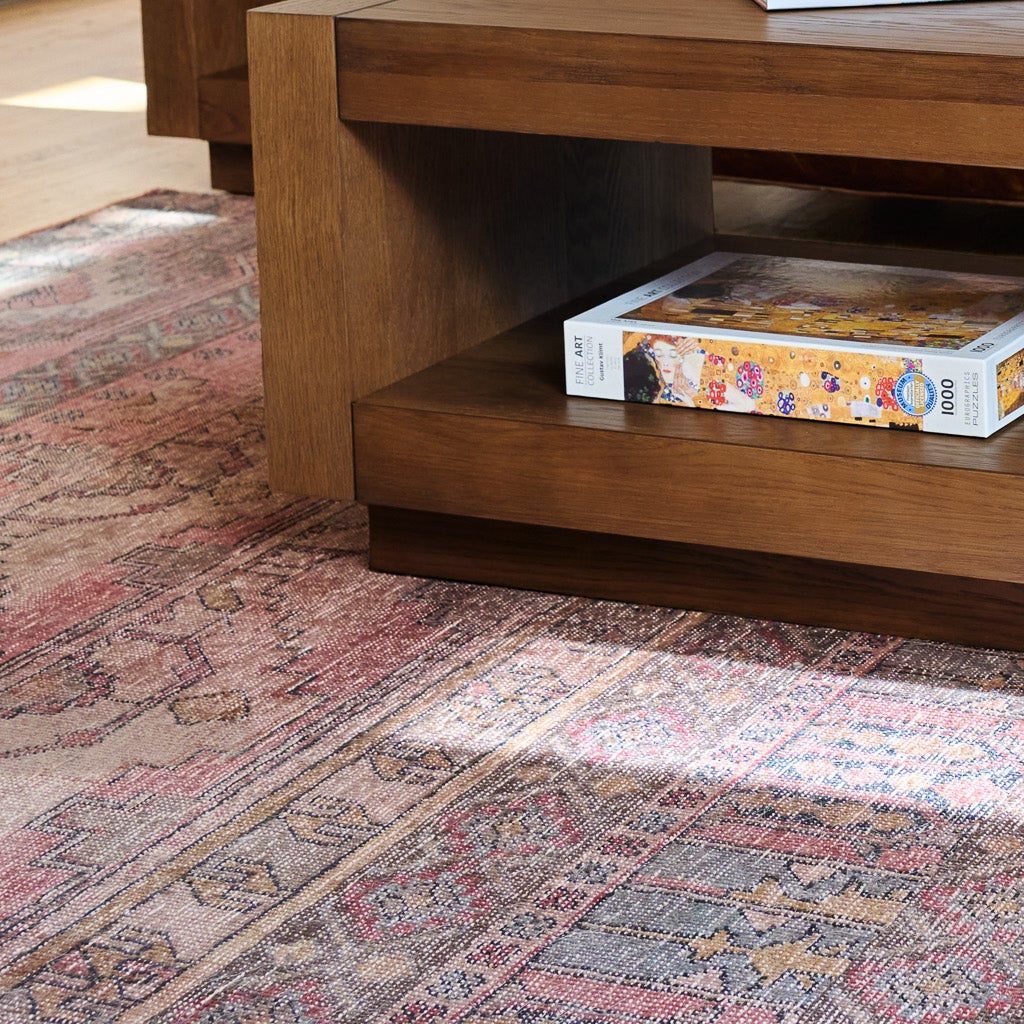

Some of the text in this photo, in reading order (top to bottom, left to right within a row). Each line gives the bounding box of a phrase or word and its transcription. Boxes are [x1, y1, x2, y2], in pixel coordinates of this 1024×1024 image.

[574, 335, 584, 385] FINE ART
[586, 336, 595, 386] COLLECTION
[896, 377, 908, 409] MUSEUM
[926, 383, 935, 410] QUALITY
[941, 378, 954, 416] 1000
